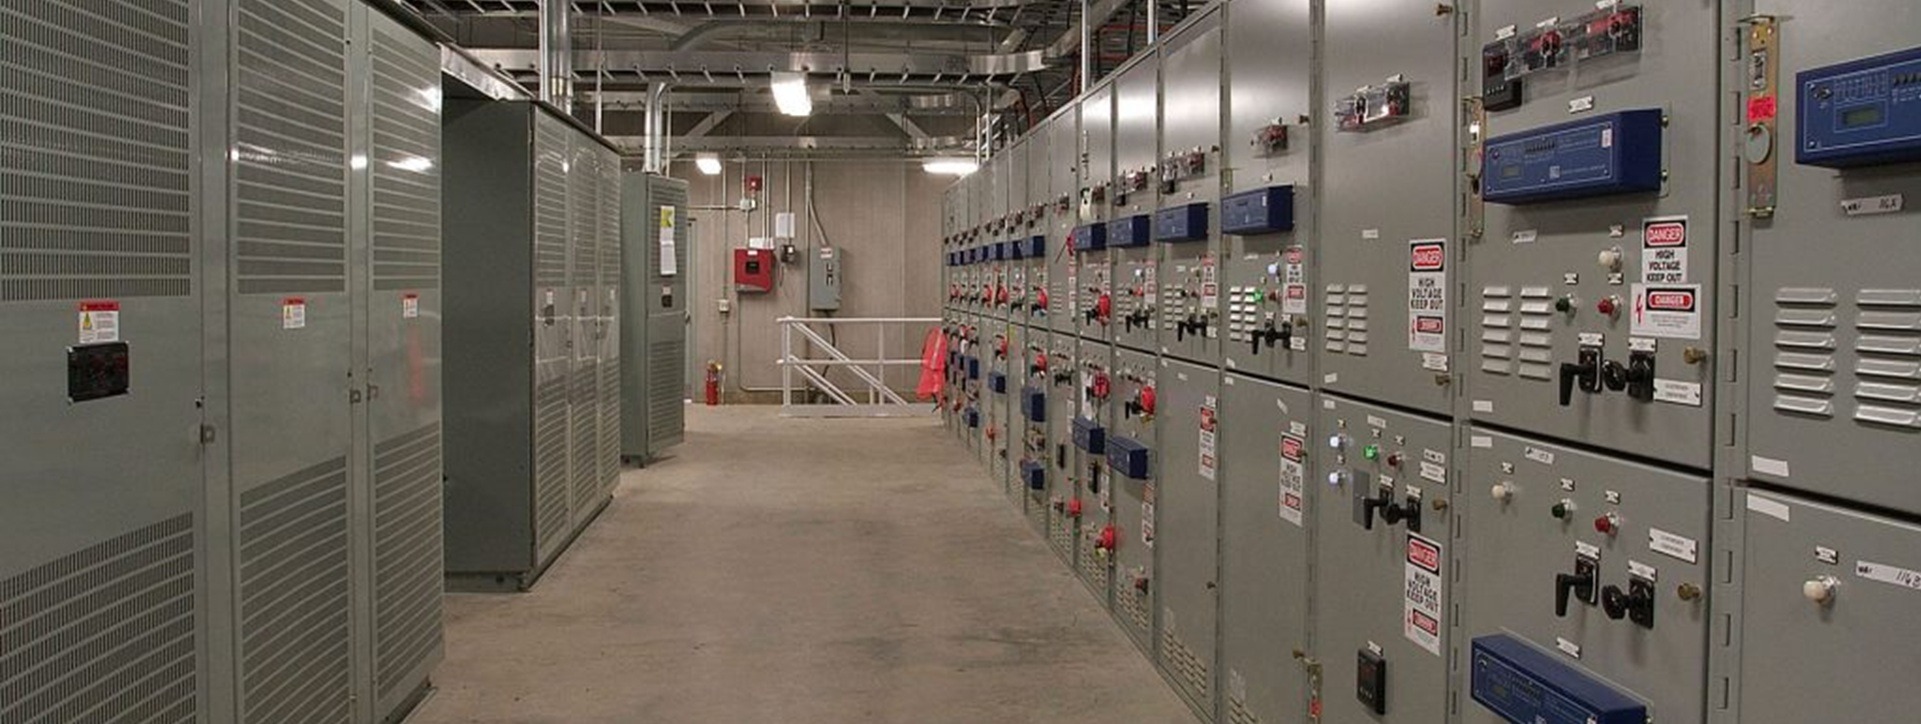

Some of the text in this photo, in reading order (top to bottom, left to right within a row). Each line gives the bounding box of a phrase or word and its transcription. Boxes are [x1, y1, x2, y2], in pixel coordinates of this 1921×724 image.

[1648, 226, 1683, 242] DANGER
[1655, 250, 1675, 259] HIGH
[1648, 261, 1681, 271] VOLTAGE
[1418, 278, 1435, 287] HIGH
[1646, 273, 1682, 283] KEEP OUT
[1412, 288, 1442, 299] VOLTAGE
[1411, 299, 1443, 310] KEEP OUT
[1415, 571, 1430, 587] HIGH
[1408, 580, 1437, 602] VOLTAGE
[1407, 589, 1439, 613] KEEP OUT
